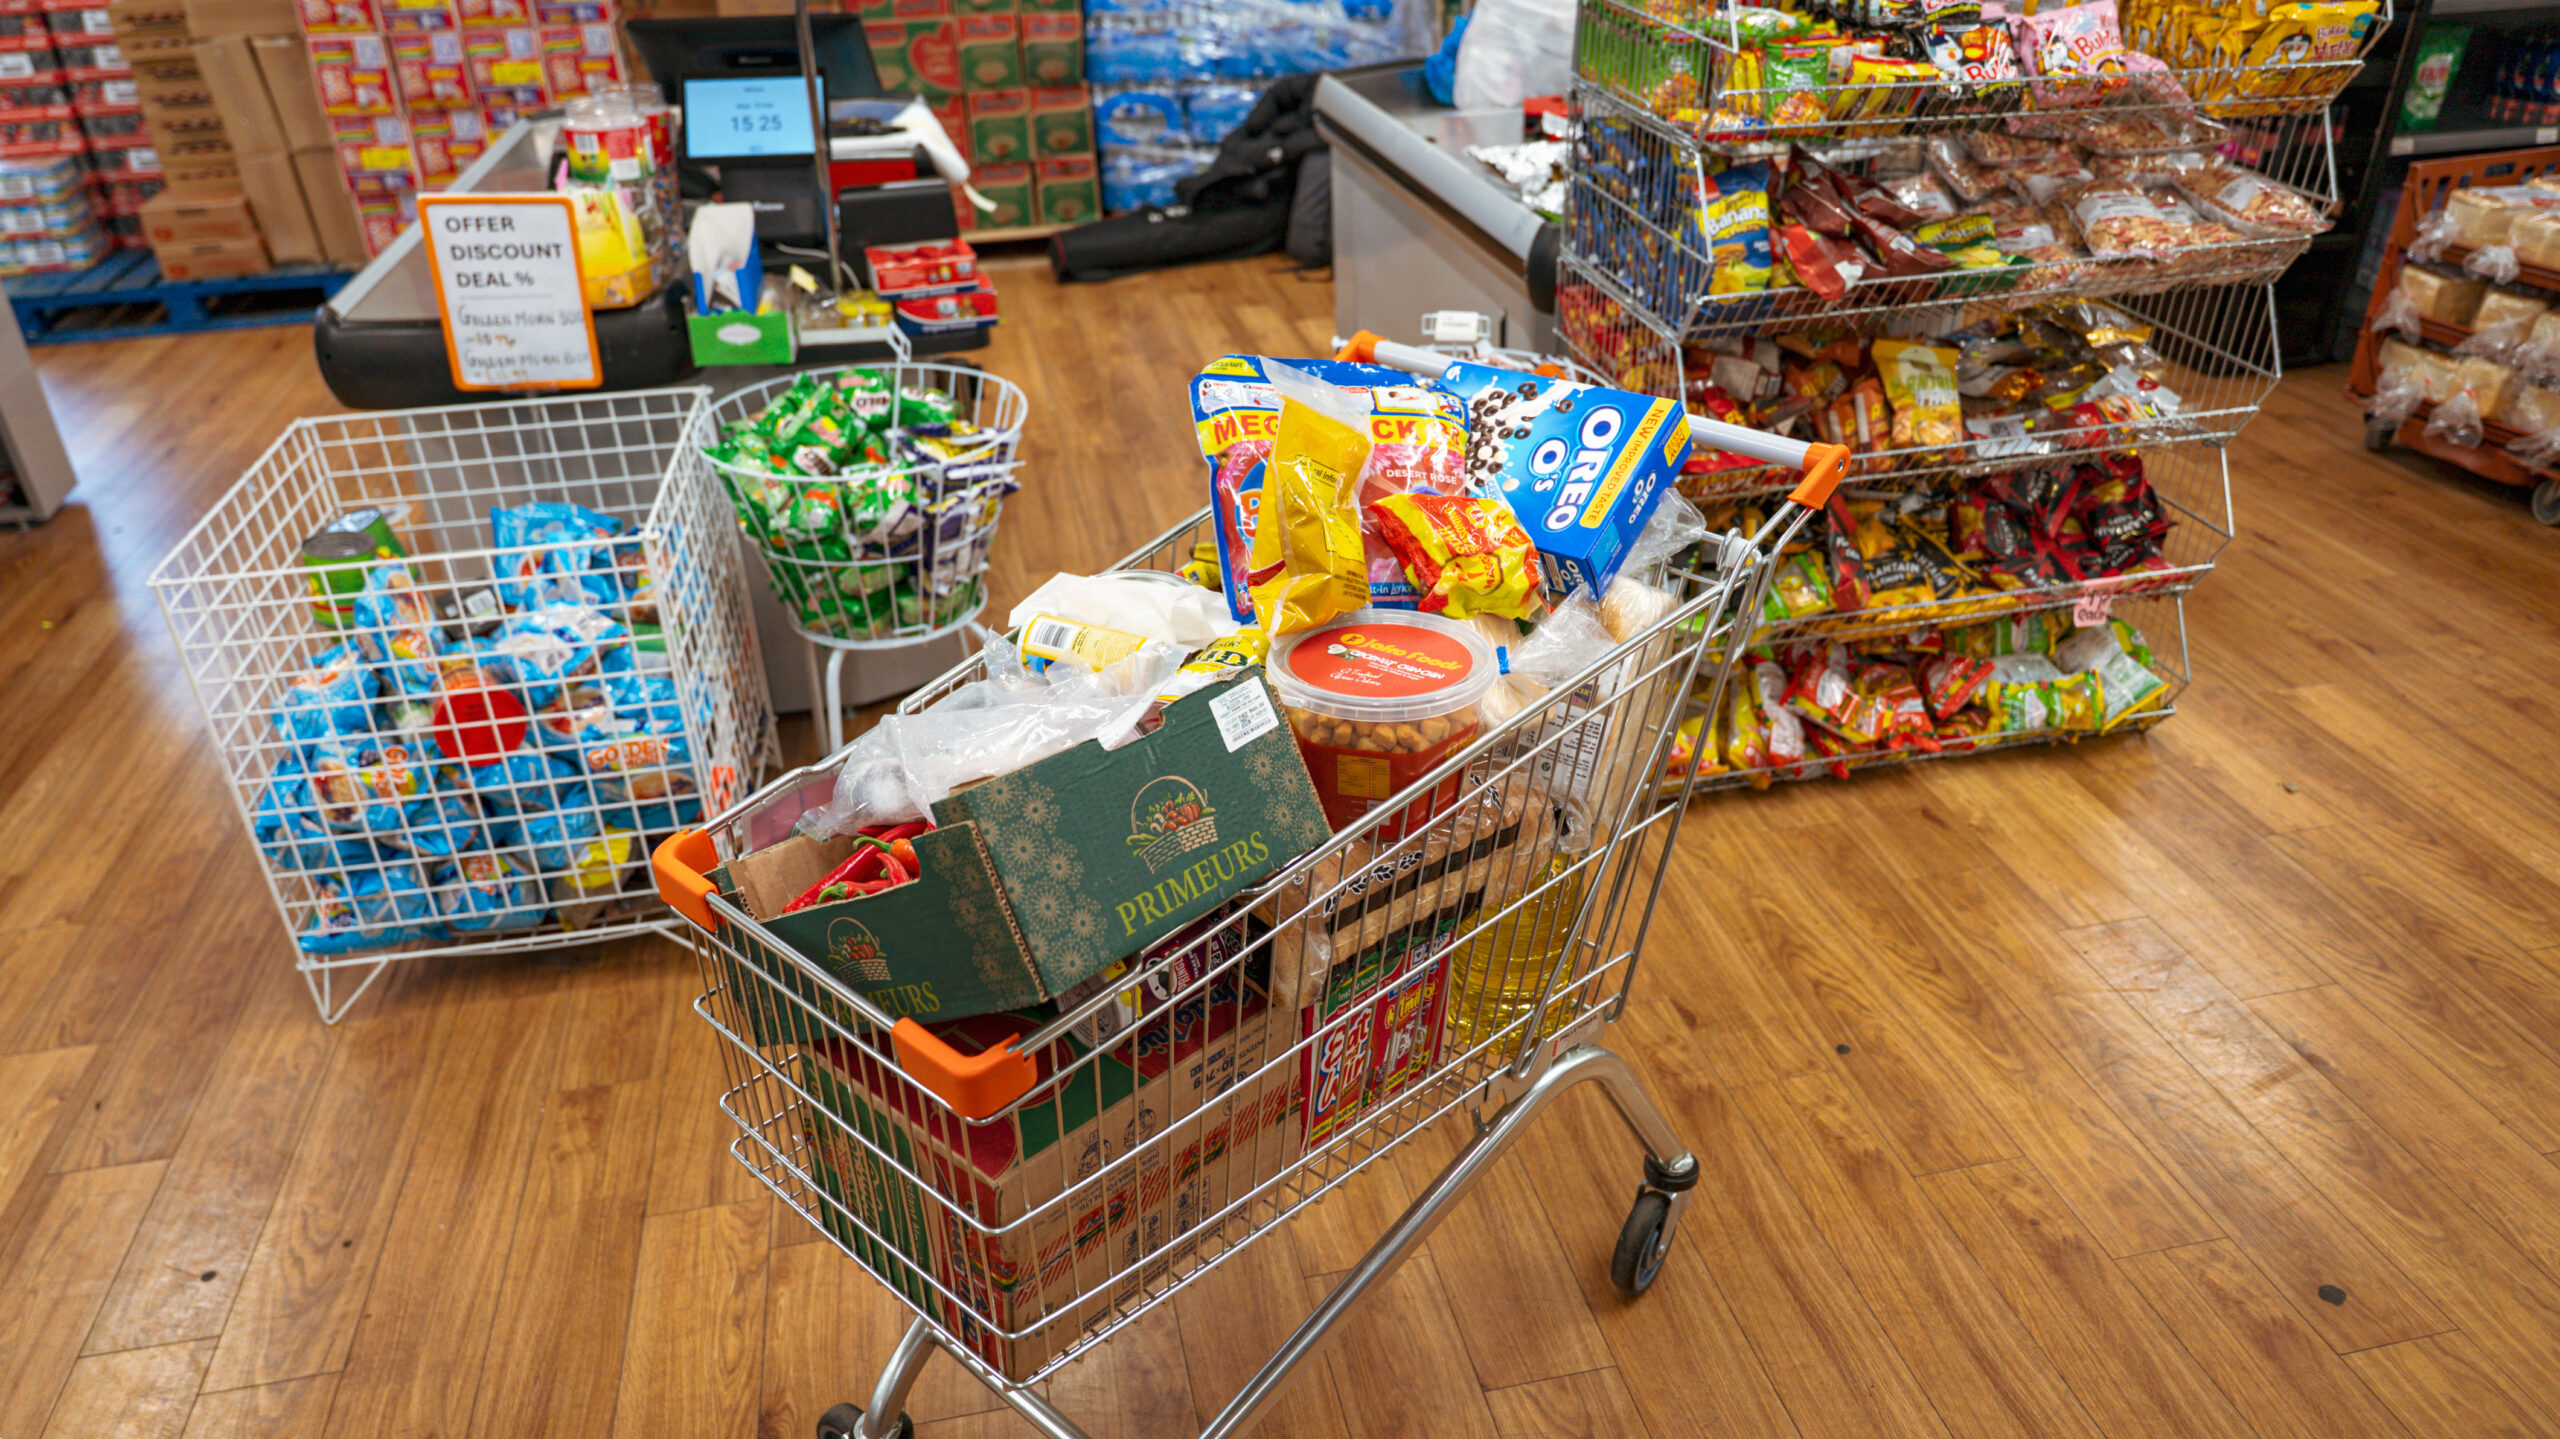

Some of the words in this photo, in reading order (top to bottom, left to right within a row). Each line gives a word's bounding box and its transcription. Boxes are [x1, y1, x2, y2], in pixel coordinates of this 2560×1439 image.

[731, 114, 753, 132] 15
[759, 114, 783, 132] 25
[445, 215, 515, 233] OFFER
[450, 243, 563, 261] DISCOUNT
[456, 272, 511, 288] DEAL
[515, 271, 534, 286] %
[1213, 414, 1279, 445] MEG
[1372, 419, 1420, 441] CK
[1639, 408, 1664, 440] NEW
[1386, 469, 1427, 480] DESERT
[1430, 472, 1458, 485] ROSE
[1545, 406, 1623, 530] OREO
[1607, 439, 1642, 490] IMPROVED
[1587, 491, 1612, 522] TASTE
[1628, 471, 1657, 524] OREO
[1115, 831, 1269, 937] PRIMEURS
[1338, 979, 1358, 1001] Instnt
